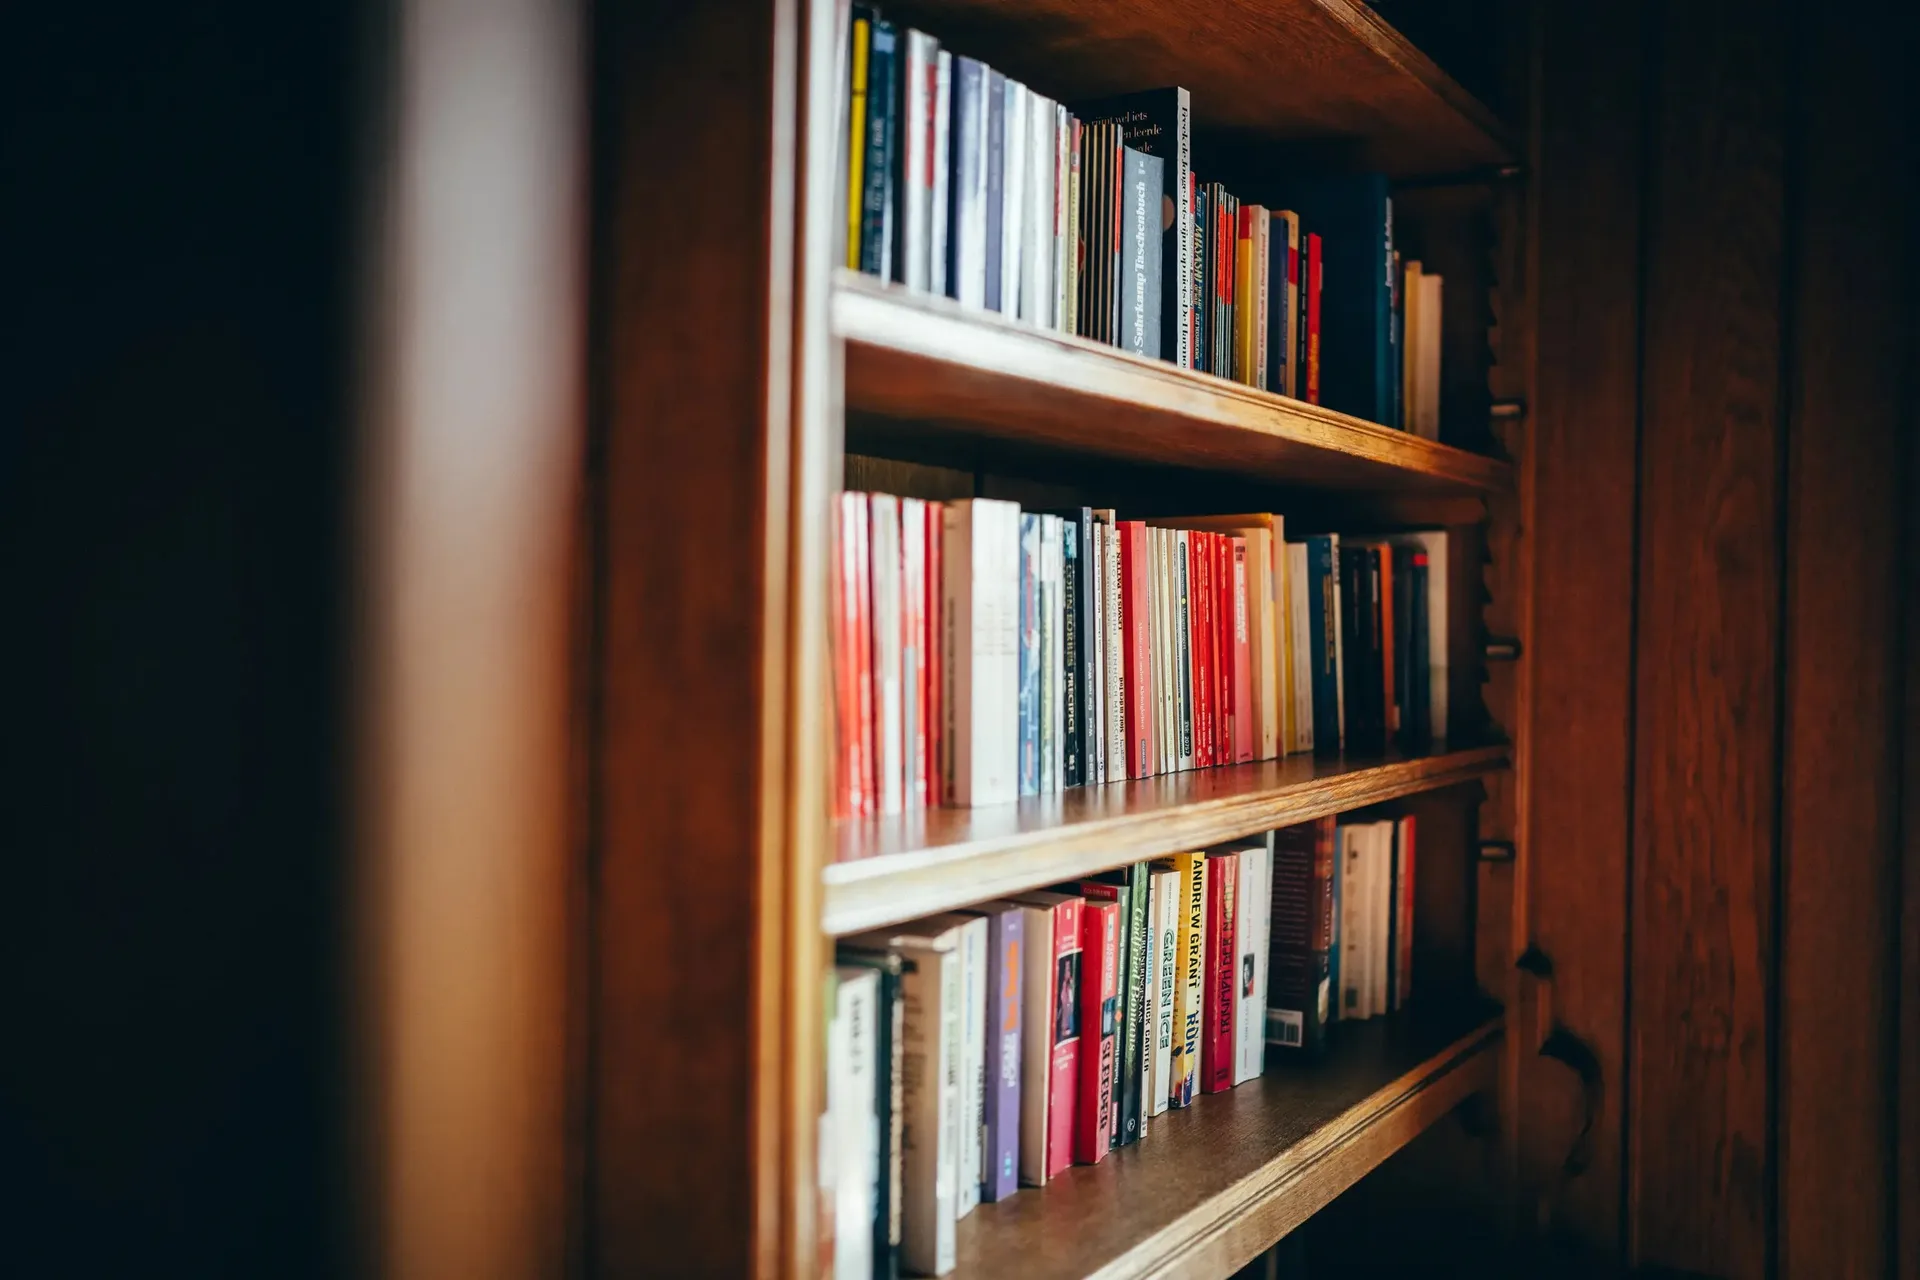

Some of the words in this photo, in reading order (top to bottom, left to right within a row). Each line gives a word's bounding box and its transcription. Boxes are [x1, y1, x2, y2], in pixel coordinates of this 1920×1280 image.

[1132, 110, 1148, 121] iets
[1133, 123, 1162, 139] leerde
[1182, 142, 1188, 158] de
[1180, 159, 1188, 194] Jonge
[1135, 180, 1147, 275] Taschenbuch
[1180, 221, 1188, 252] rijmt
[1180, 253, 1188, 269] op
[1193, 223, 1203, 285] MUSASHI
[1133, 274, 1146, 347] Suhrkamp
[1190, 860, 1203, 929] ANDREW
[1223, 883, 1234, 933] NACHT
[1131, 907, 1143, 980] Godfried
[1139, 927, 1147, 1004] HERINNERINGEN
[1161, 928, 1175, 1009] GREEN
[1188, 933, 1200, 990] GRANT
[1222, 936, 1233, 966] DER
[1128, 985, 1140, 1052] Bomans
[1159, 1010, 1171, 1050] ICE
[1185, 1011, 1199, 1056] RUN
